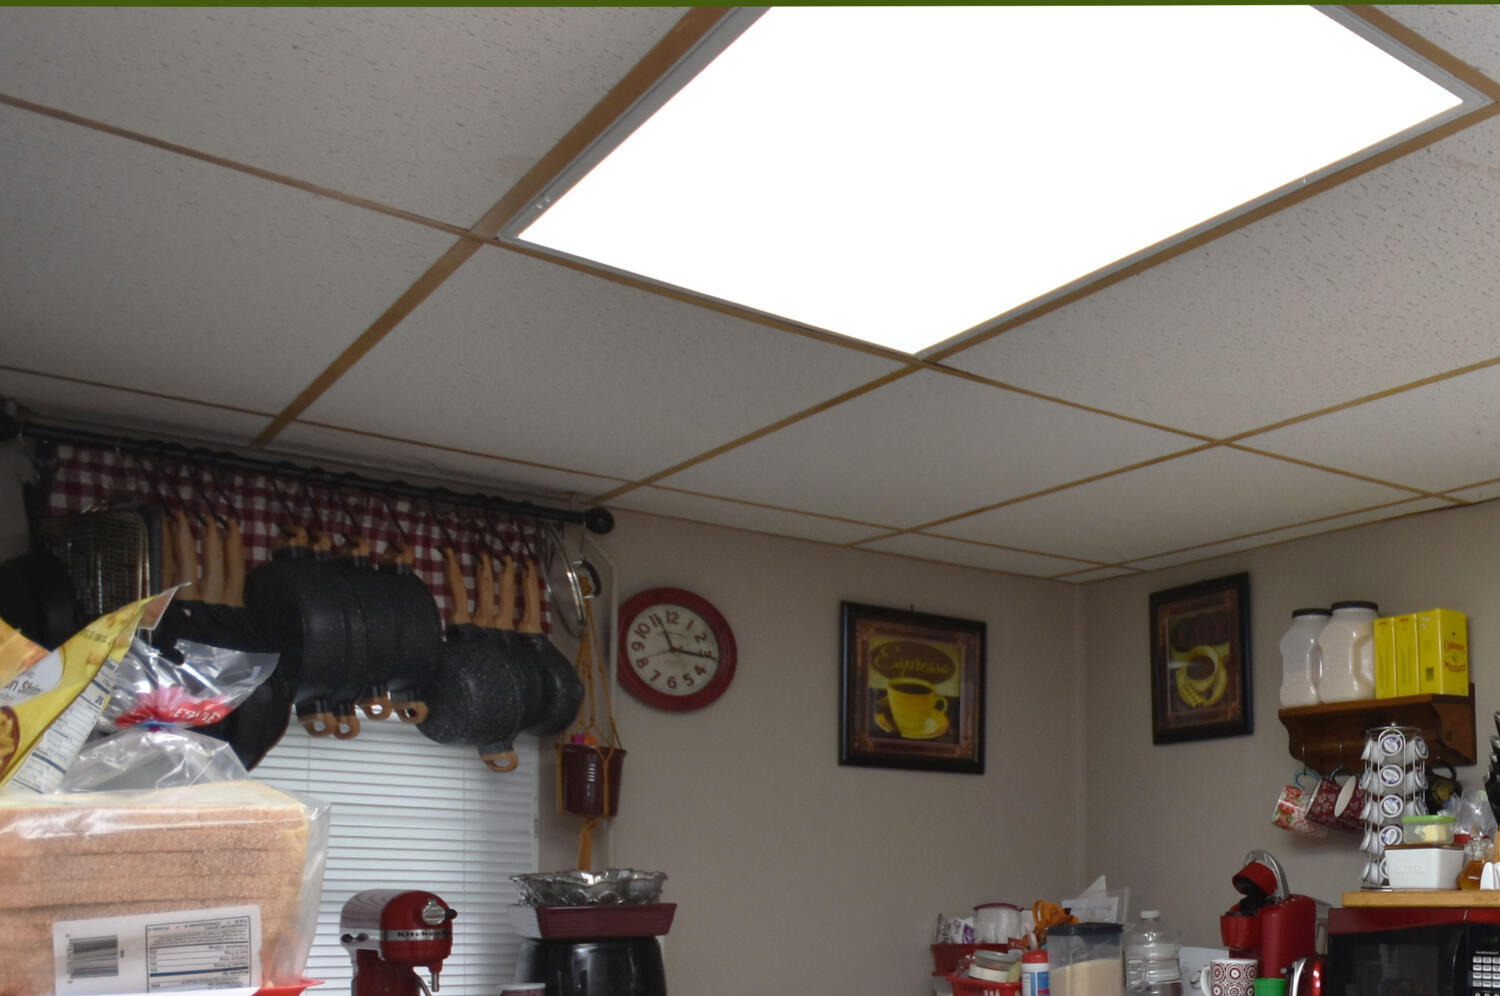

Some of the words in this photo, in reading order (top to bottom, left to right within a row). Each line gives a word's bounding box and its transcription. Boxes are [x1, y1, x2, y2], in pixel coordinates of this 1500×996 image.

[665, 610, 680, 625] 12
[634, 622, 651, 640] 10
[686, 619, 695, 631] 1
[694, 632, 708, 644] 2
[631, 641, 645, 652] 9
[636, 657, 649, 669] 8
[650, 669, 662, 682] 7
[694, 664, 707, 676] 4
[667, 676, 677, 689] 6
[683, 673, 695, 687] 5
